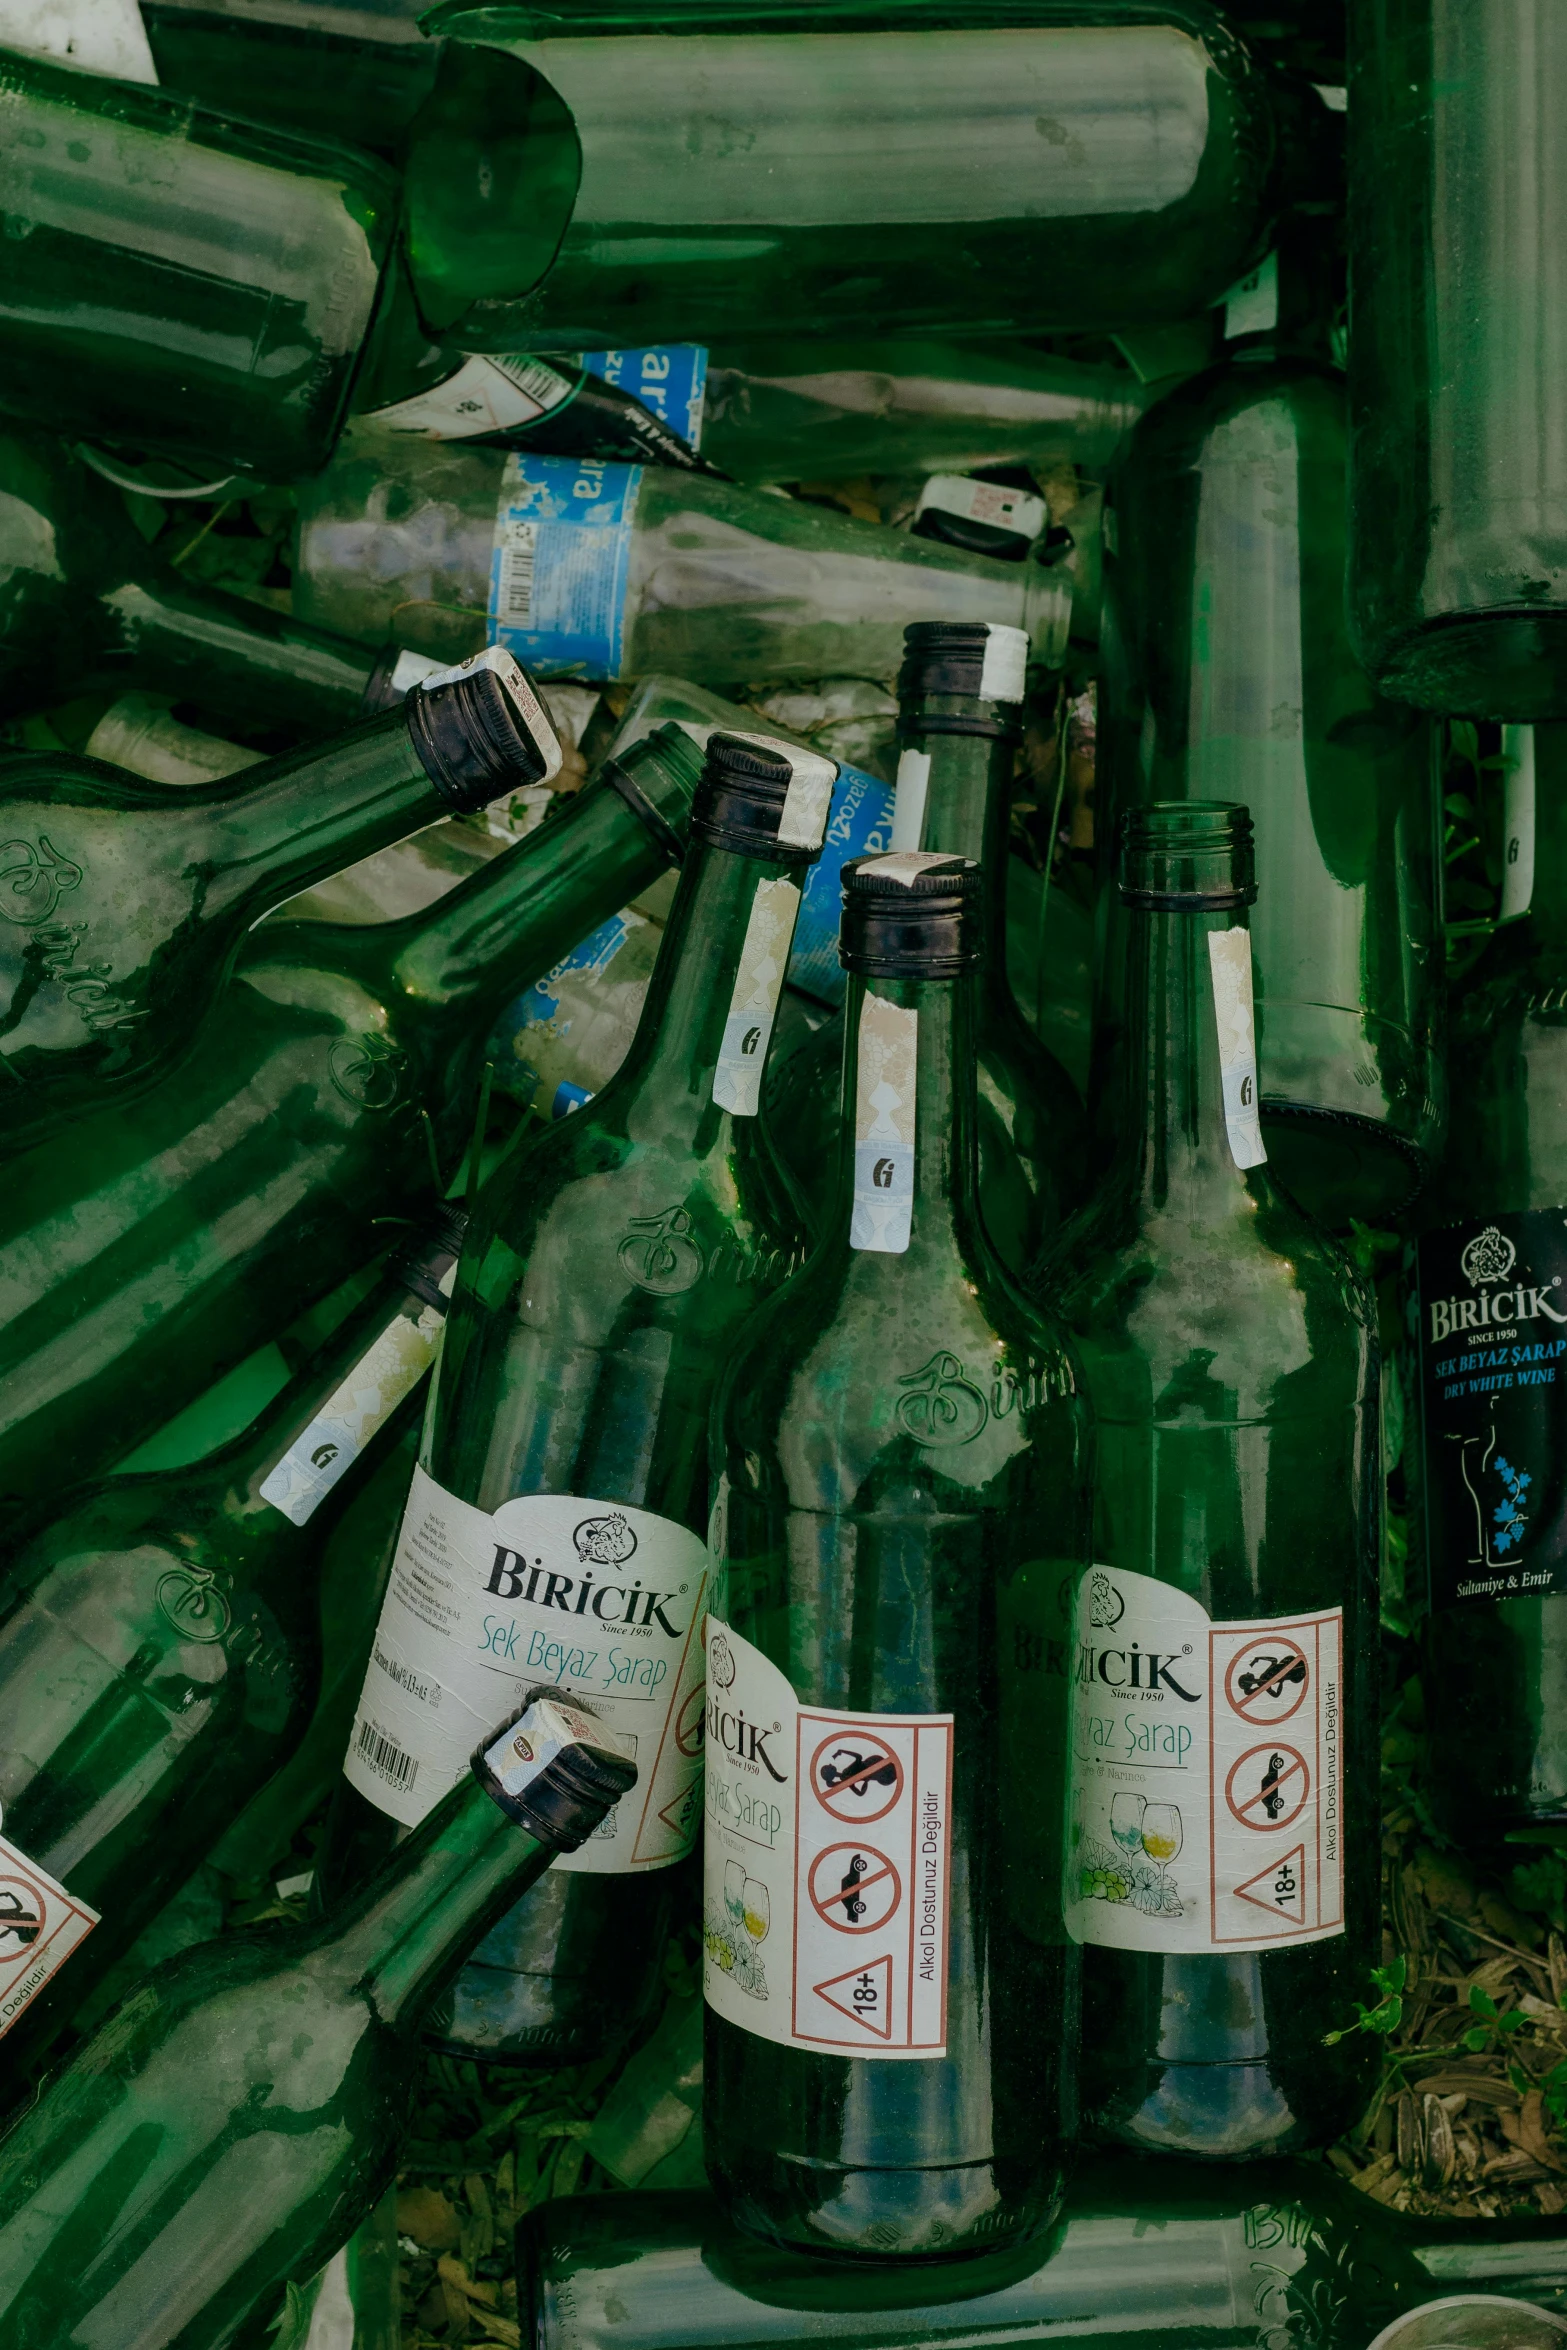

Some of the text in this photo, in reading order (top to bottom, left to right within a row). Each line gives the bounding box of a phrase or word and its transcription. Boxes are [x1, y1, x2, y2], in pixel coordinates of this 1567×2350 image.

[640, 353, 669, 421] ar
[1468, 1328, 1518, 1346] SINCE 1950
[1435, 1340, 1567, 1379] SEK BEYAZ ŞARAP
[1444, 1367, 1556, 1400] DRY WHITE WINE
[1457, 1577, 1505, 1598] Sultaniye
[1507, 1575, 1519, 1589] &
[1521, 1569, 1554, 1588] Emir
[600, 1622, 653, 1638] Since 1950
[478, 1615, 667, 1697] Sek Beyaz Şarap
[1111, 1688, 1165, 1702] Since 1950
[1125, 1713, 1192, 1765] Şarap
[726, 1752, 760, 1776] Since 1950
[1325, 1681, 1338, 1861] Alkol Dostunuz Değildir
[735, 1782, 781, 1845] Şarap
[919, 1791, 942, 1981] Alkol Dostunuz Değildir
[1275, 1865, 1296, 1906] 18+
[2, 1965, 48, 2017] Değildir
[853, 1973, 878, 2015] 18+
